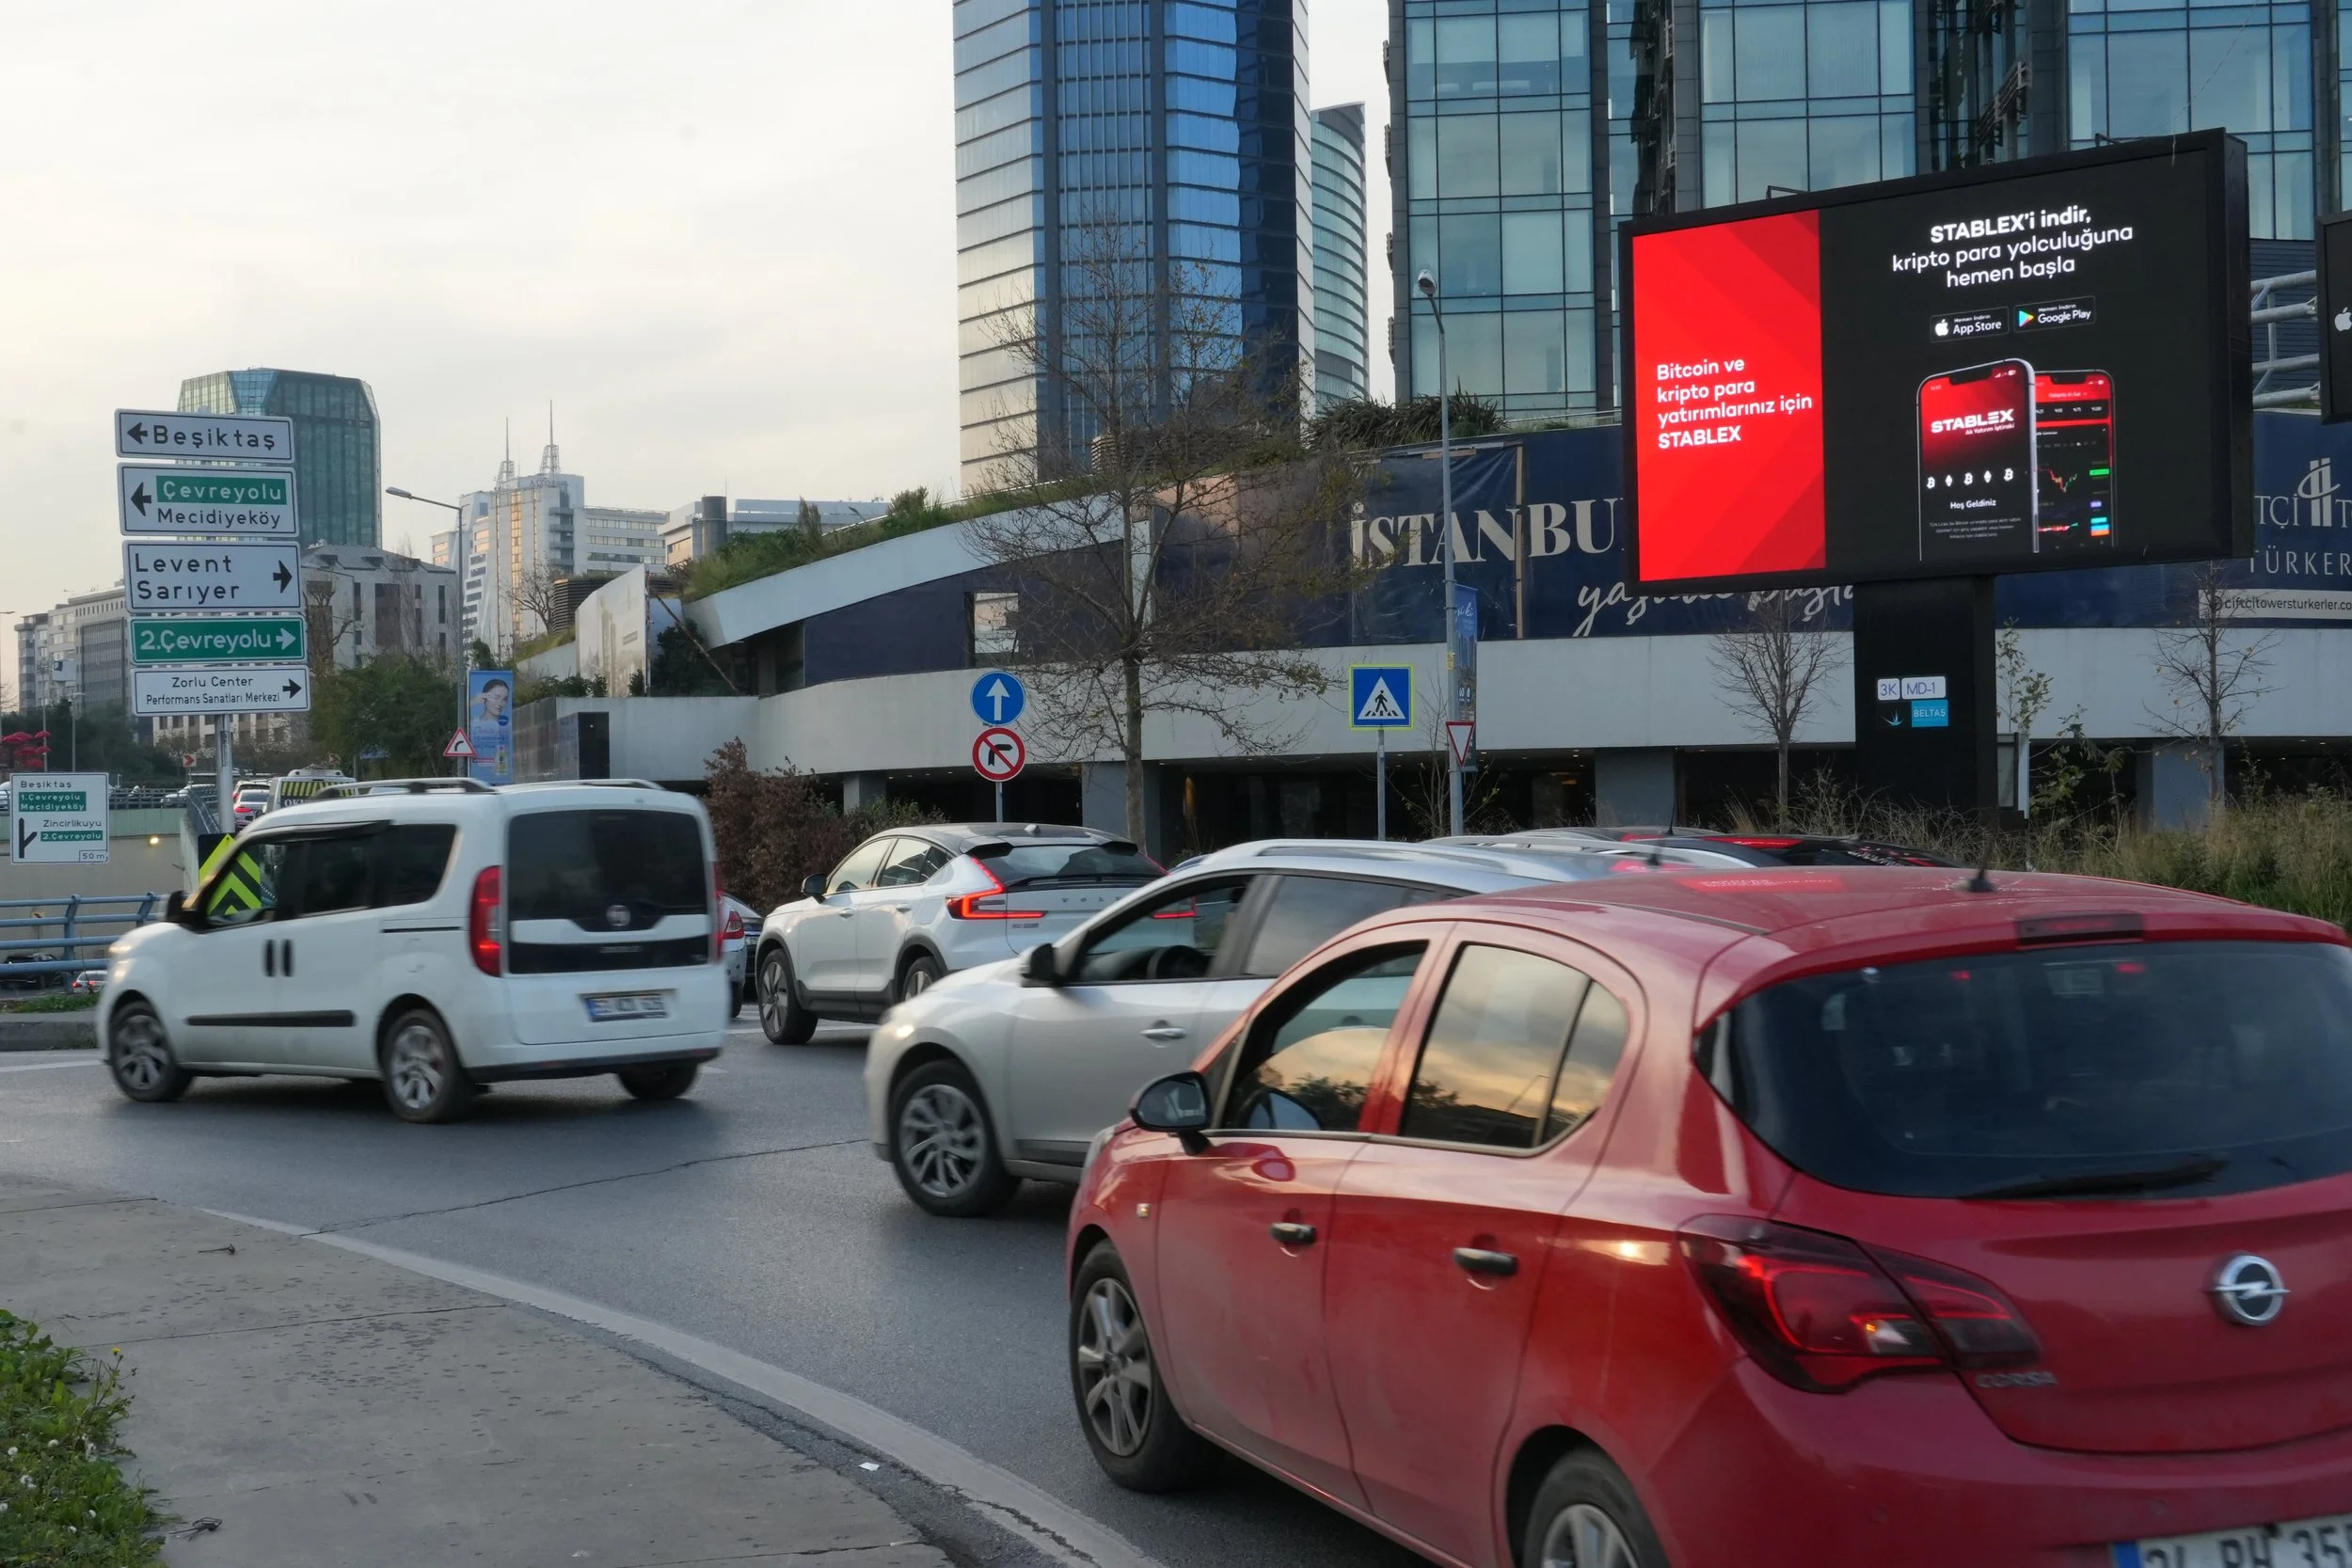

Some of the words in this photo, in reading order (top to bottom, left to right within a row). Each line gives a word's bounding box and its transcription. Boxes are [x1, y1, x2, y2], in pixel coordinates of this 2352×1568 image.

[2041, 205, 2091, 228] indir,
[1893, 252, 1950, 273] kripto
[1956, 245, 2001, 268] para
[2008, 227, 2133, 261] yolculuğuna
[1947, 266, 2013, 287] hemen
[2020, 256, 2075, 278] başla
[1953, 324, 1974, 335] App
[1976, 321, 2002, 331] Store
[2038, 312, 2071, 324] Google
[2072, 309, 2091, 321] Play
[1657, 359, 1719, 380] Bitcoin
[1724, 359, 1745, 372] ve
[1657, 384, 1708, 404] kripto
[1714, 380, 1755, 401] para
[1658, 400, 1775, 429] yatırımlarınız
[1780, 393, 1813, 415] için
[1931, 408, 2014, 433] STABLEX
[153, 424, 276, 451] Beşiktaş
[1658, 425, 1741, 449] STABLEX
[163, 481, 281, 502] Çevreyolu
[1965, 499, 1996, 508] Geldiniz
[2254, 493, 2299, 529] TÇİ
[157, 508, 280, 529] Mecidiyeköy
[1350, 501, 1624, 569] İSTANBU
[135, 553, 232, 573] Levent
[137, 580, 240, 604] Sarıyer
[141, 628, 271, 654] 2.Çevreyolu
[171, 676, 206, 688] Zorlu
[211, 675, 253, 688] Center
[1881, 683, 1898, 696] 3K
[1906, 682, 1935, 695] MD-1
[146, 694, 200, 705] Performans
[202, 693, 243, 704] Sanatları
[246, 692, 280, 703] Merkezi
[43, 819, 102, 828] Zincirlikuyu
